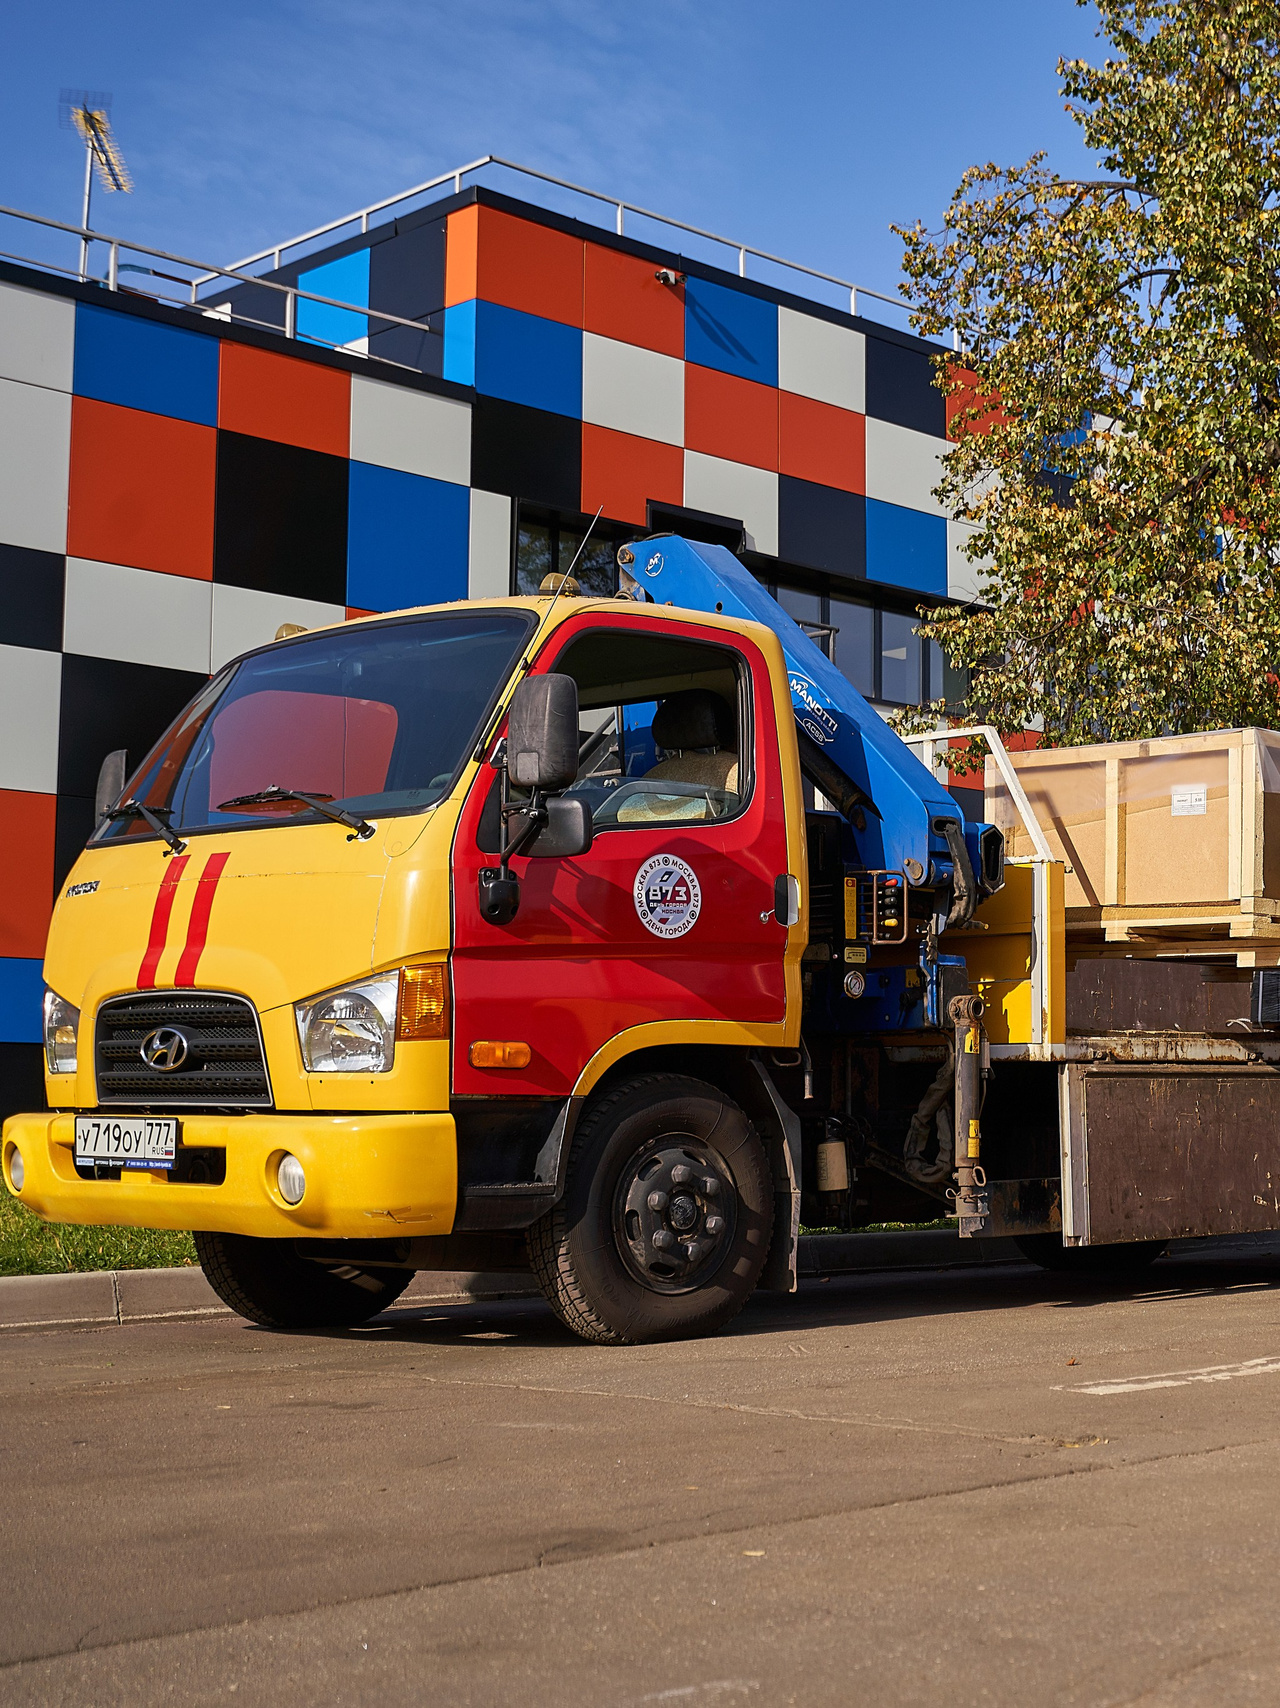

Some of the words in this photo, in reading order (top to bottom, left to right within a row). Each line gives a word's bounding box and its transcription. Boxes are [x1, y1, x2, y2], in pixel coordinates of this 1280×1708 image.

[790, 678, 838, 732] MANOTTI
[636, 869, 650, 908] МОСКВА
[649, 858, 661, 870] 873
[649, 886, 687, 901] 873
[671, 859, 697, 891] МОСКВА
[692, 892, 700, 909] 873
[645, 918, 664, 934] ДЕНЬ
[664, 919, 692, 935] ГОРОДА
[146, 1122, 171, 1146] 777
[152, 1146, 165, 1156] RUS
